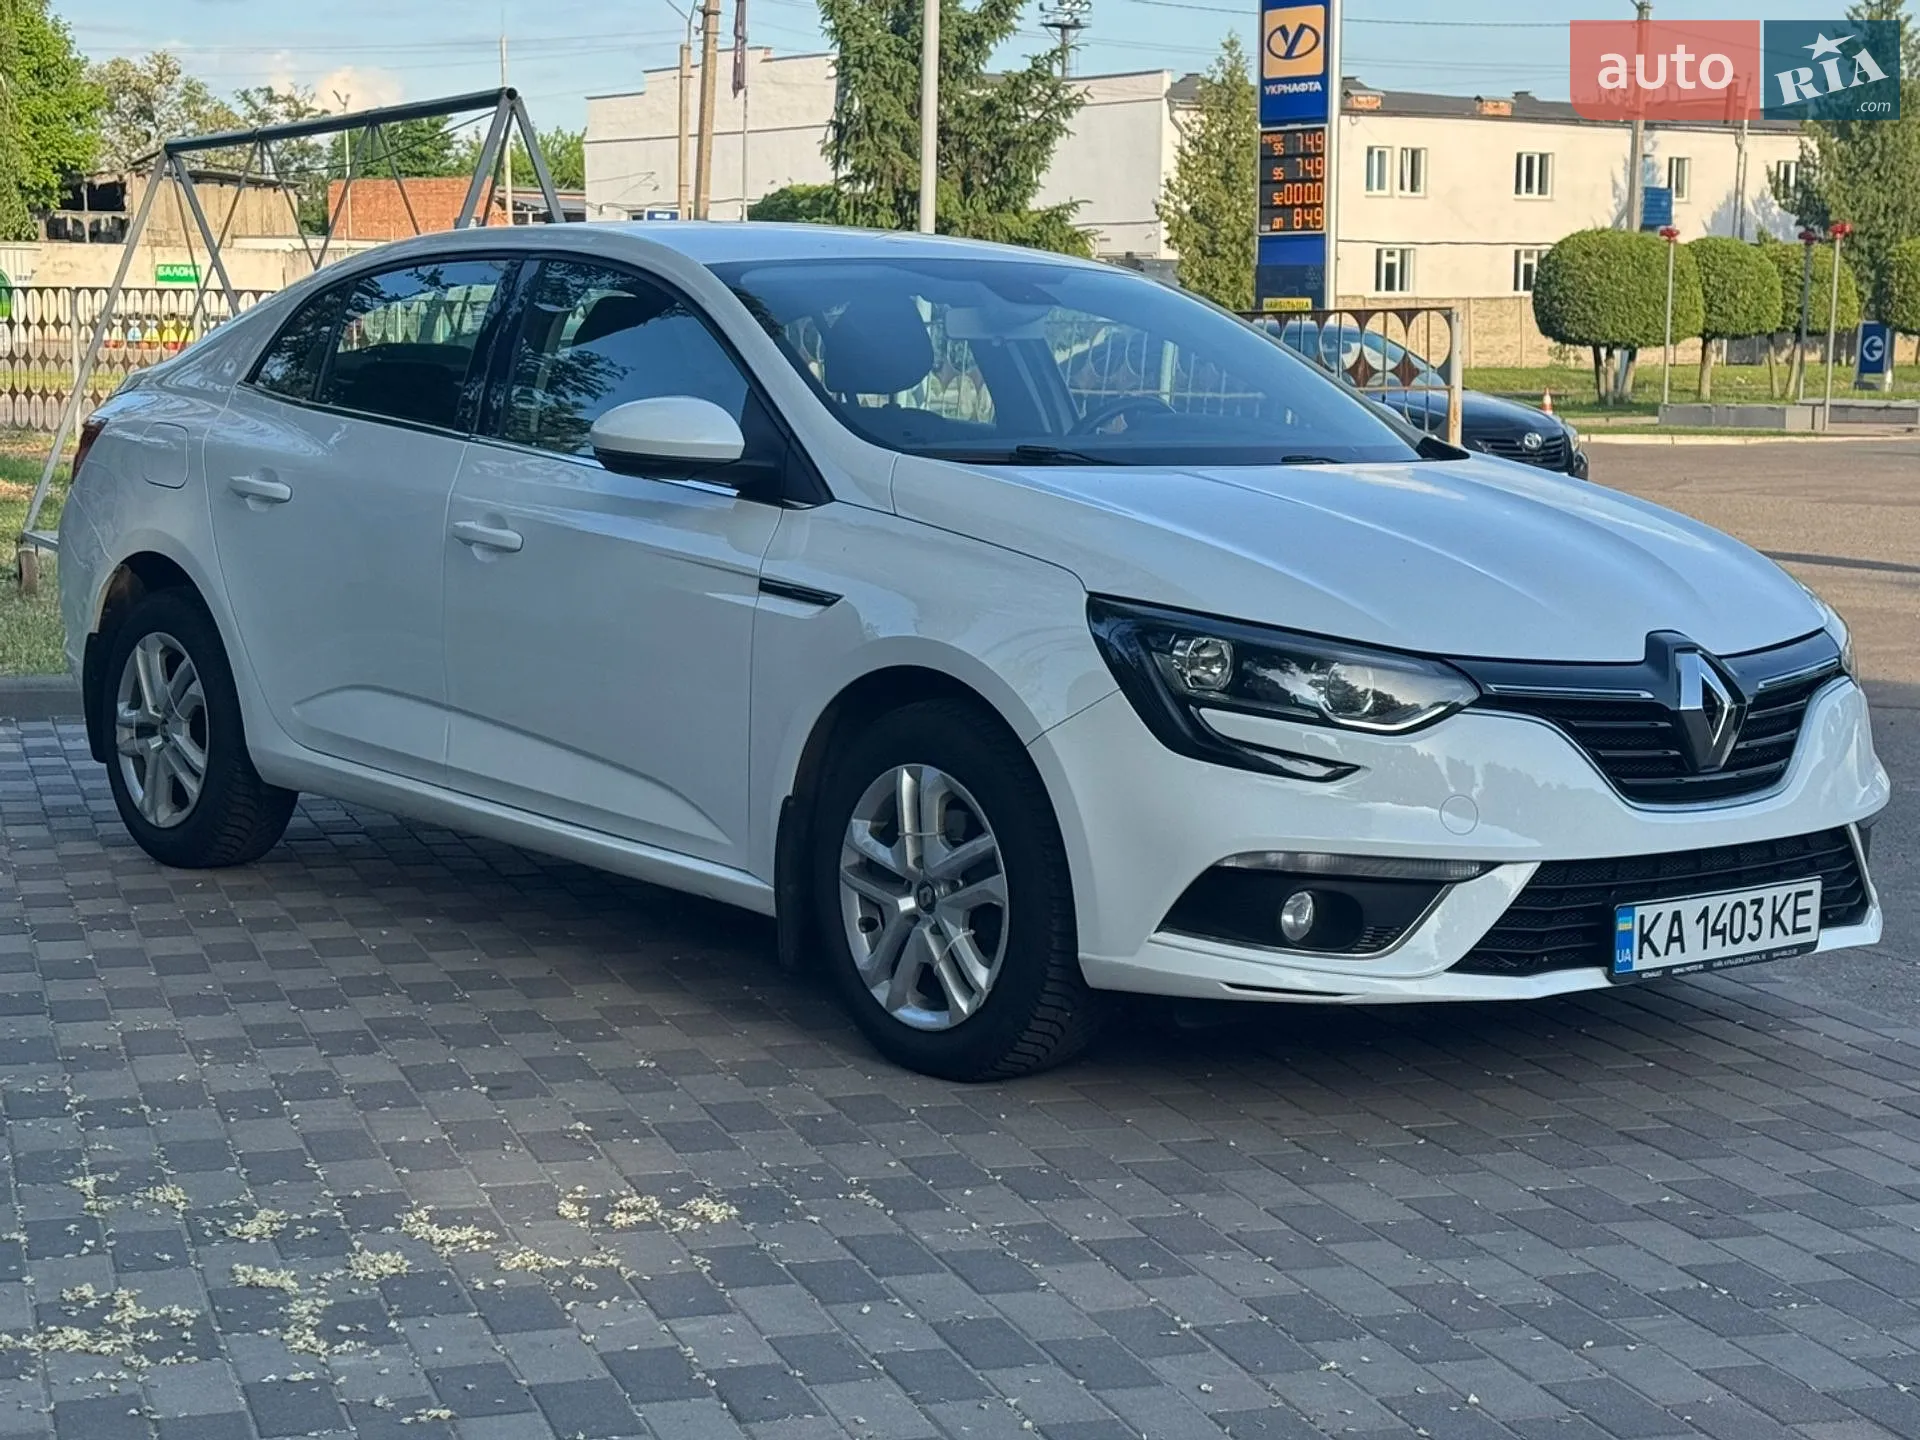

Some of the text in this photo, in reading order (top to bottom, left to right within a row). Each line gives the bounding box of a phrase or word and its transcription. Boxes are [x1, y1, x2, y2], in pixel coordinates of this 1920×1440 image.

[1264, 81, 1322, 95] УКРНАФТА
[1272, 166, 1285, 180] 95
[1615, 948, 1632, 964] UA
[1695, 897, 1765, 950] 1403
